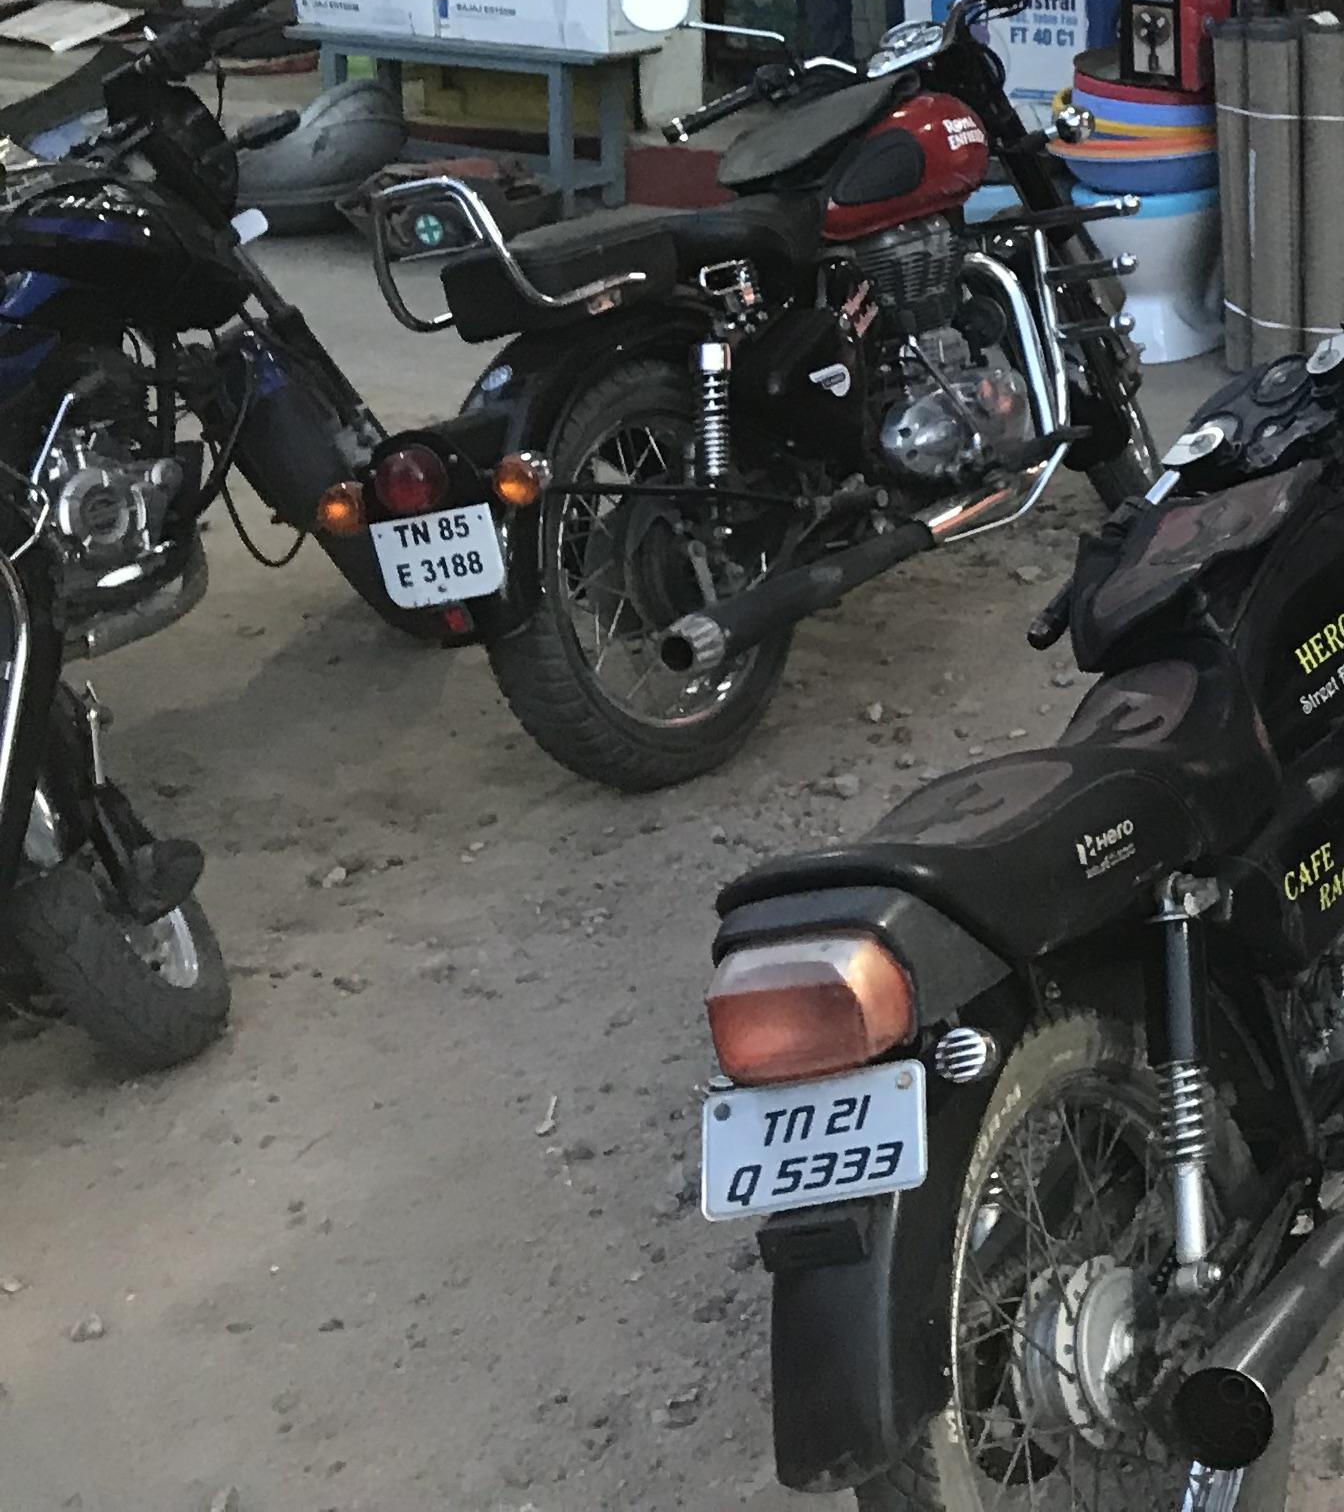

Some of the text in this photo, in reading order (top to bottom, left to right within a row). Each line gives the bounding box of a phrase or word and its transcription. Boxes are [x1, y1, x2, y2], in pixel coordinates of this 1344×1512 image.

[1010, 26, 1075, 47] FT 40 C1
[393, 513, 471, 549] TN 85
[396, 550, 484, 588] E 3188
[1096, 818, 1135, 852] Hero
[1283, 842, 1336, 902] CAFE
[763, 1094, 872, 1147] TN 21
[727, 1140, 905, 1207] Q 5333
